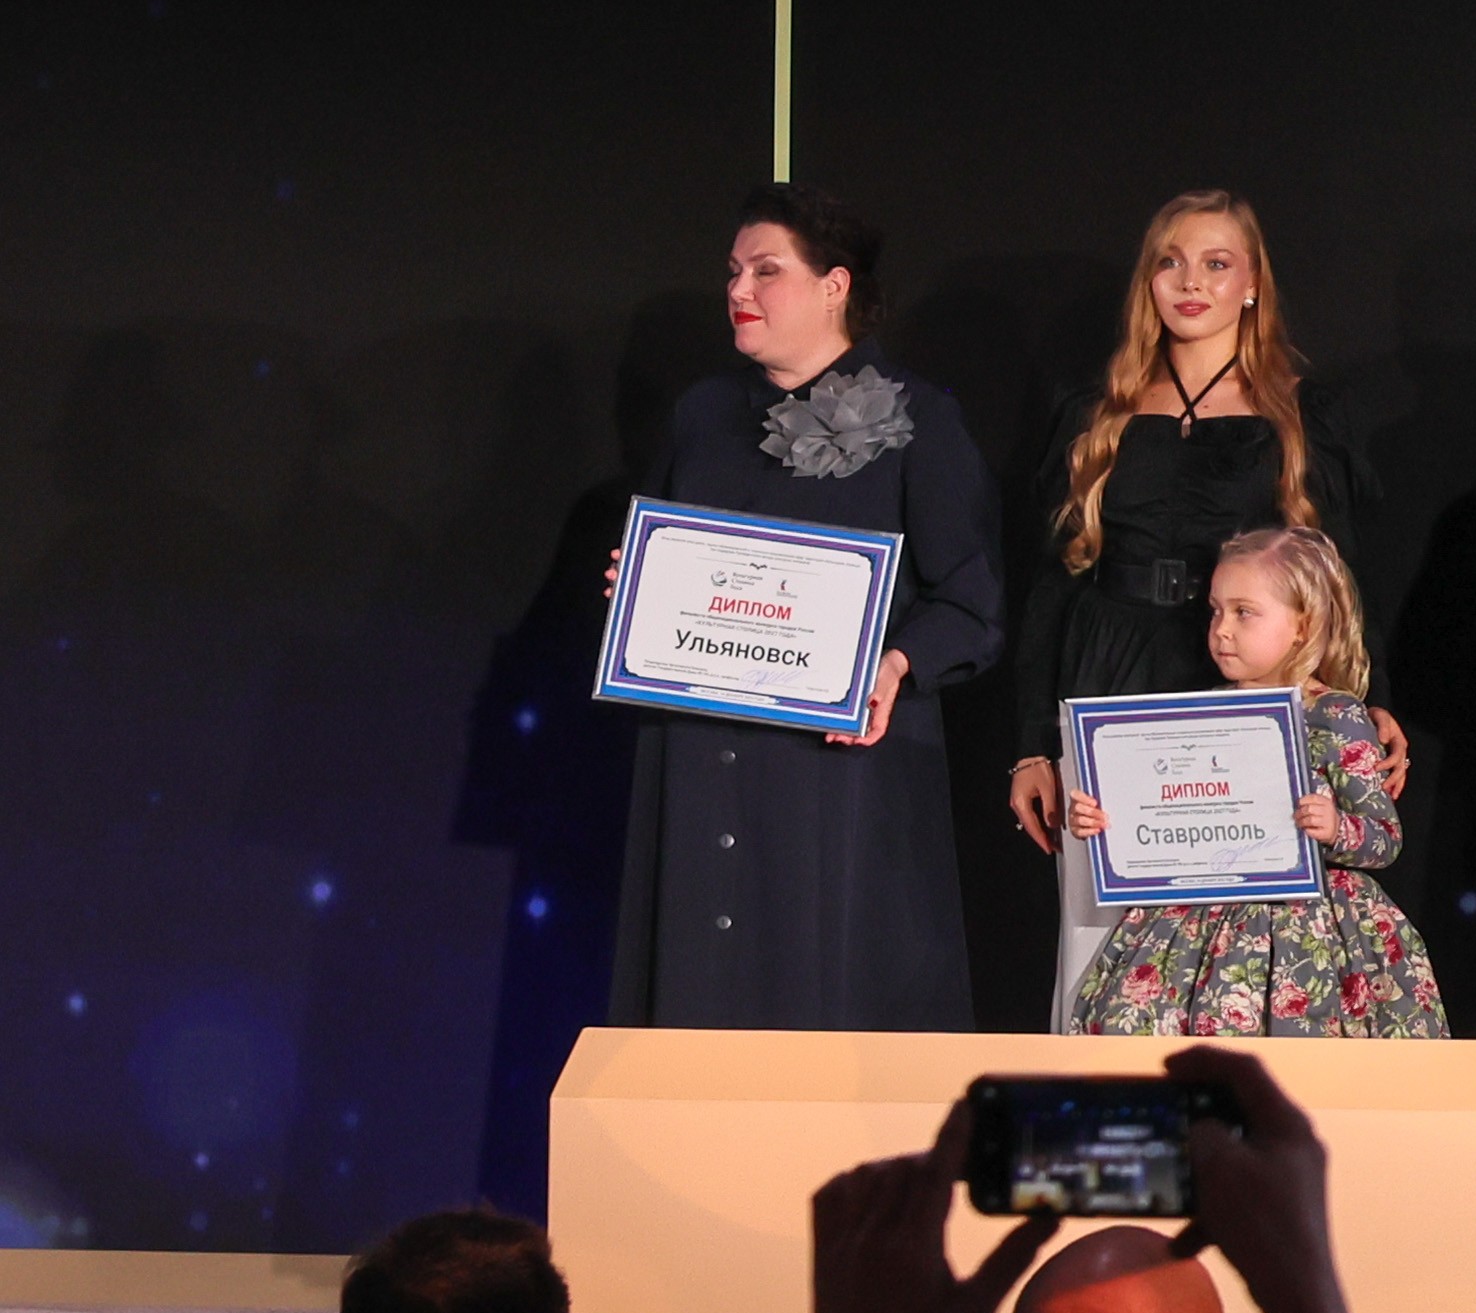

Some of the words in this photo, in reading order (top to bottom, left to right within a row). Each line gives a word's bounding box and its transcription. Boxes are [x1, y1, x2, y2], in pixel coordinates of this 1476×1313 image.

[708, 596, 792, 621] ДИПЛОМ
[675, 629, 810, 668] Ульяновск
[1161, 781, 1230, 802] ДИПЛОМ
[1136, 824, 1265, 848] Ставрополь
